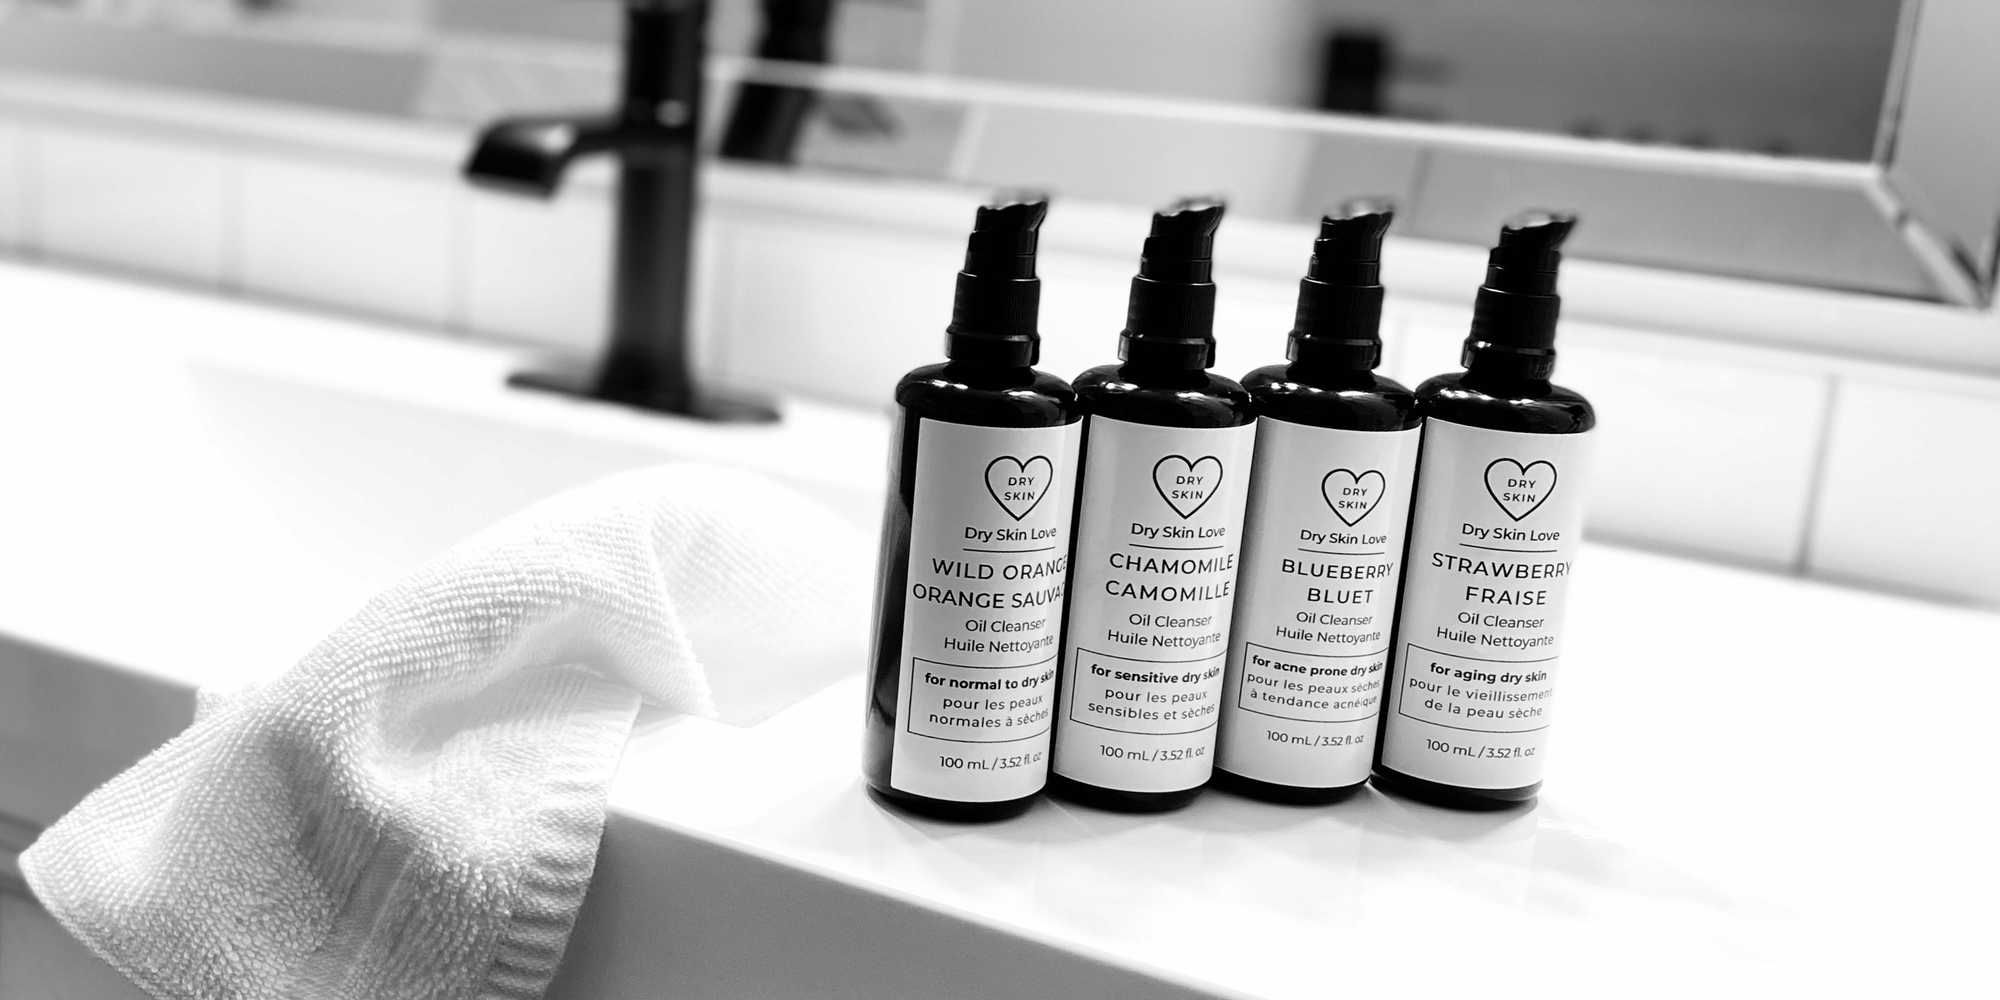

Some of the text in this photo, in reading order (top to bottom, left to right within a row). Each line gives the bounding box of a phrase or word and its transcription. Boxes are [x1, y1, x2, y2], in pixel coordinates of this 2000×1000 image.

[1008, 477, 1035, 486] DRY
[1176, 476, 1204, 484] DRY
[1508, 479, 1536, 489] DRY
[1004, 492, 1035, 500] SKIN
[1172, 490, 1203, 499] SKIN
[1343, 488, 1368, 496] DRY
[1503, 493, 1536, 503] SKIN
[1338, 501, 1367, 509] SKIN
[965, 527, 1057, 542] Dry Skin Love
[1131, 523, 1225, 539] Dry Skin Love
[1300, 530, 1387, 545] Dry Skin Love
[1462, 523, 1560, 541] Dry Skin Love
[932, 558, 994, 579] WILD
[1109, 553, 1234, 574] CHAMOMILE
[1282, 559, 1393, 579] BLUEBERRY
[1432, 552, 1573, 579] STRAWBERRY
[913, 583, 1004, 608] ORANGE
[1106, 580, 1230, 601] CAMOMILLE
[1307, 588, 1373, 604] BLUET
[1466, 586, 1547, 606] FRAISE
[965, 618, 1046, 632] Oil Cleanser
[1129, 614, 1212, 628] Oil Cleanser
[1296, 612, 1373, 626] Oil Cleanser
[1458, 612, 1545, 628] Oil Cleanser
[944, 635, 1054, 653] Huile Nettoyante
[1107, 629, 1221, 649] Huile Nettoyante
[1276, 626, 1380, 645] Huile Nettoyante
[1437, 626, 1554, 650] Huile Nettoyante
[1091, 664, 1219, 684] for sensitive dry skin
[1252, 655, 1383, 677] for acne prone dry skin
[1430, 662, 1547, 685] for aging dry skin
[925, 669, 1054, 690] for normal to dry skin
[1247, 673, 1380, 695] pour les peaux sèches
[1105, 689, 1207, 704] pour les peaux
[1250, 688, 1377, 709] à tendance acnéique
[1410, 677, 1553, 702] pour le vieillissement
[943, 694, 1043, 711] pour les peaux
[1088, 703, 1215, 720] sensibles et sèches
[1424, 698, 1542, 718] de la peau sèche
[929, 708, 1049, 728] normales à sèches
[1267, 730, 1288, 742] 100
[1291, 735, 1312, 746] mL
[1314, 735, 1321, 747] /
[1321, 736, 1343, 747] 3.52
[1355, 735, 1364, 744] oz
[1100, 745, 1124, 758] 100
[1127, 750, 1150, 761] mL
[1152, 749, 1159, 762] /
[1160, 750, 1183, 761] 3.52
[1195, 746, 1205, 756] oz
[1427, 738, 1450, 753] 100
[1453, 746, 1476, 757] mL
[1478, 746, 1485, 758] /
[1486, 748, 1511, 758] 3.52
[1524, 747, 1535, 756] oz
[940, 756, 963, 769] 100
[967, 759, 989, 770] mL
[992, 758, 998, 770] /
[1000, 756, 1022, 769] 3.52
[1033, 752, 1042, 762] oz
